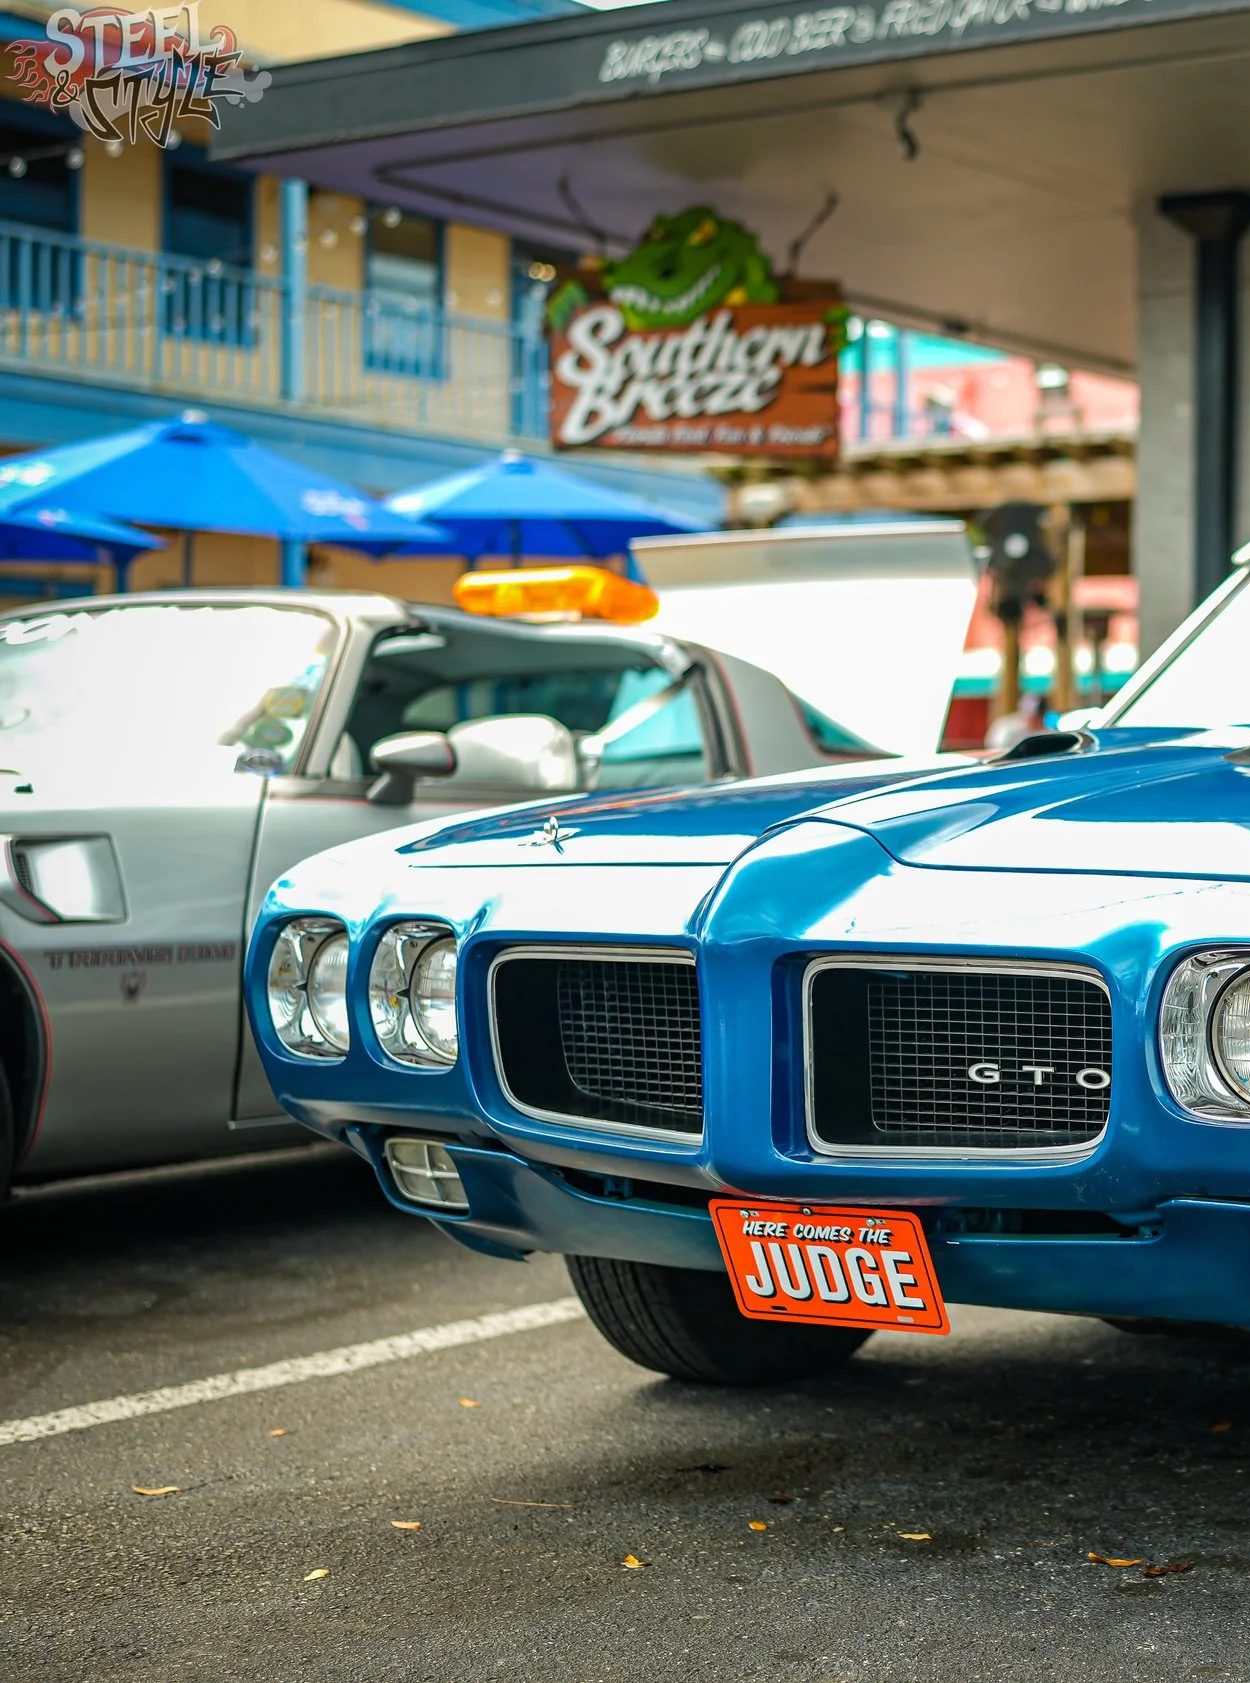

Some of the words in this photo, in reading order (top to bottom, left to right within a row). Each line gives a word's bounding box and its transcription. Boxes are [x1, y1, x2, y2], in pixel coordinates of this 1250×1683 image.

[555, 304, 828, 390] Southern
[559, 365, 784, 445] Breeze
[44, 948, 174, 969] TRANS
[968, 1062, 1111, 1090] GTO
[742, 1220, 790, 1241] HERE
[792, 1223, 854, 1244] COMES
[858, 1227, 895, 1246] THE
[744, 1241, 926, 1310] JUDGE
